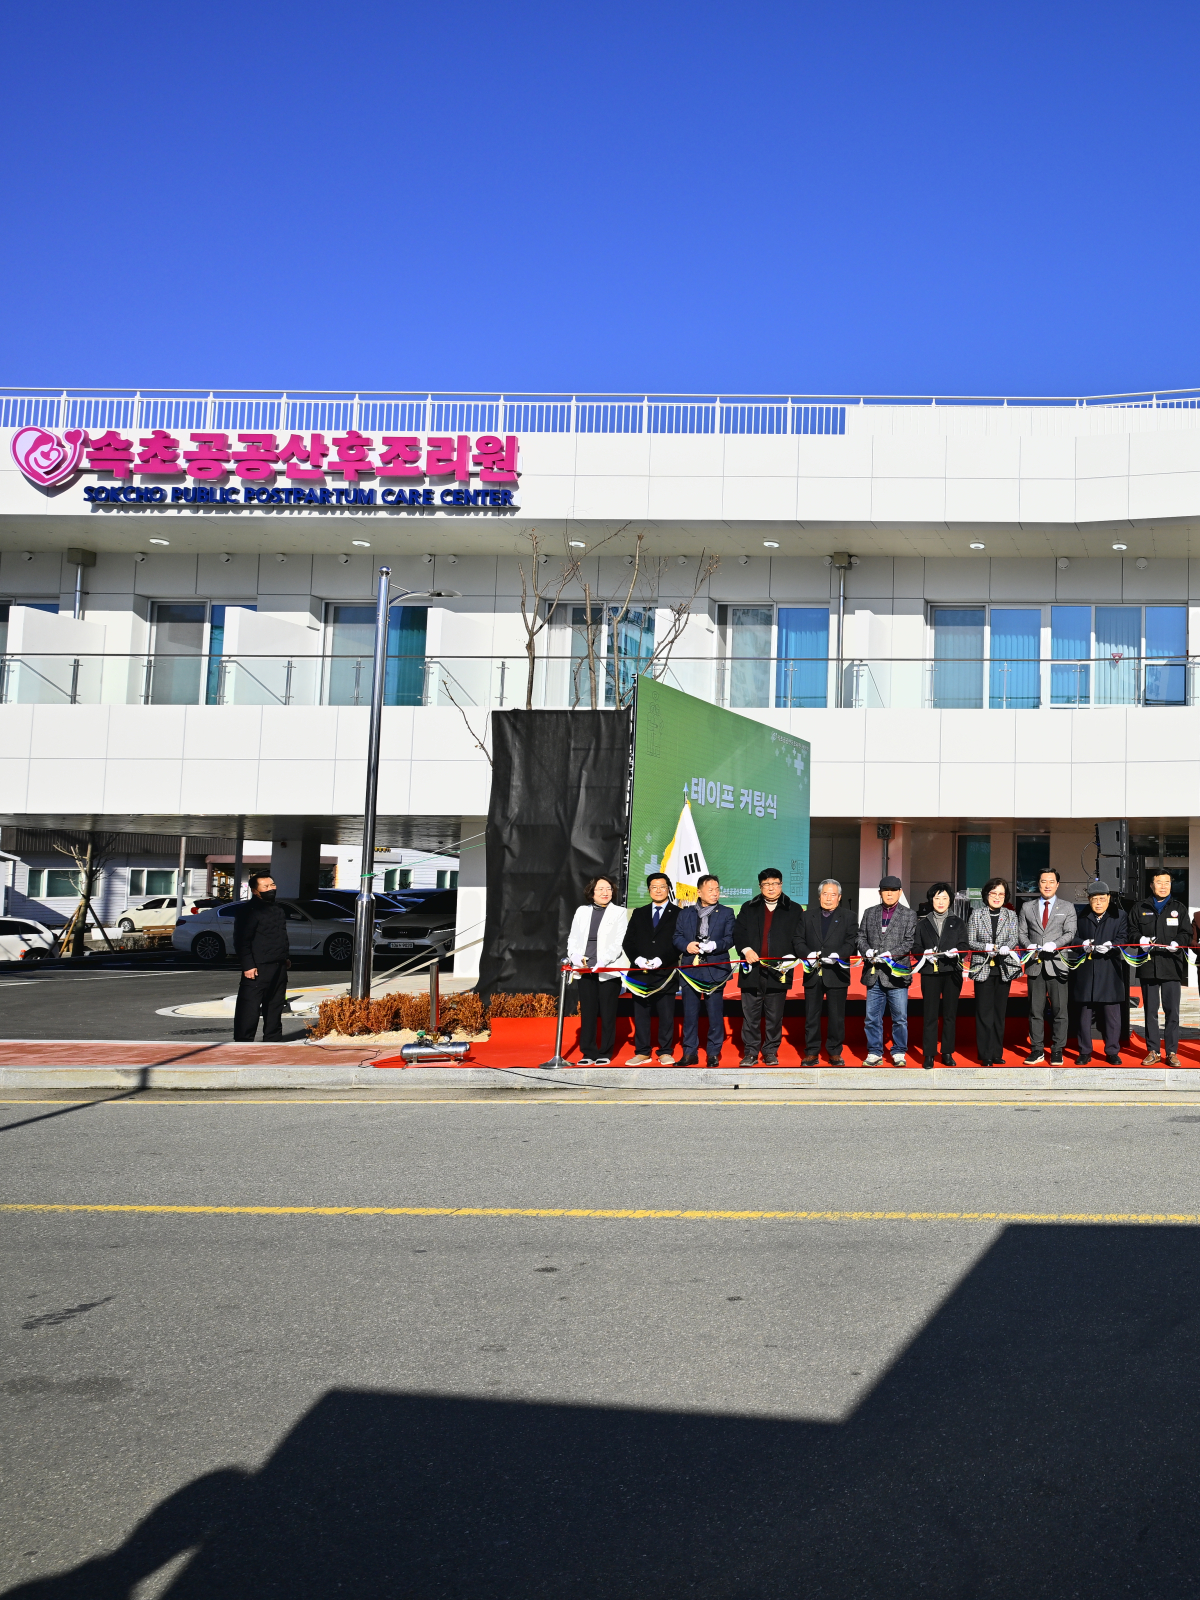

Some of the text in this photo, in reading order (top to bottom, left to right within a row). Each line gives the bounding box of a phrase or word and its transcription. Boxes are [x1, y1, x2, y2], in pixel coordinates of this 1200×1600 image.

[85, 430, 520, 482] 속초공공산후조리원
[83, 485, 515, 506] SOKCHO PUBLIC POSTPARTUM CARE CENTER
[691, 777, 778, 819] 테이프 커팅식
